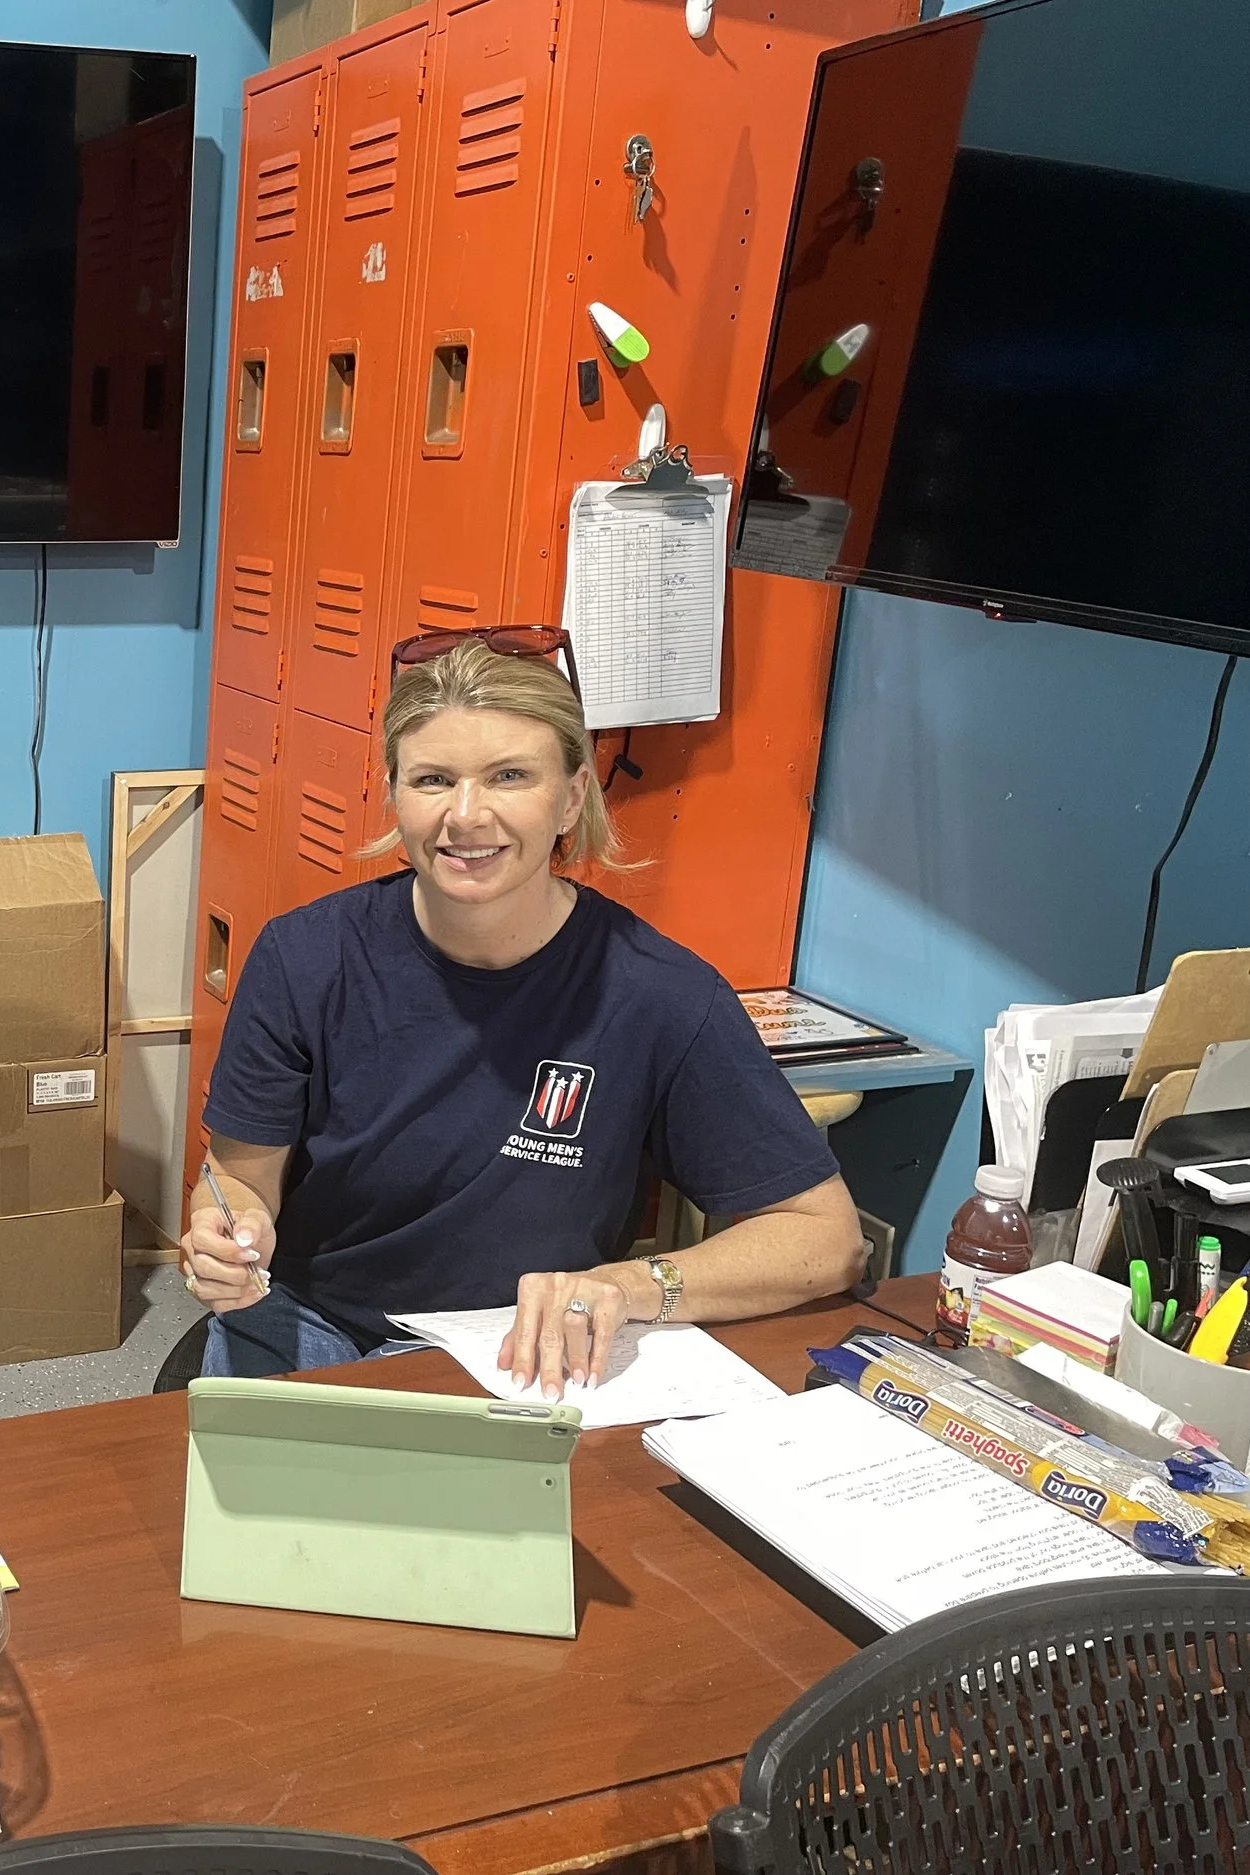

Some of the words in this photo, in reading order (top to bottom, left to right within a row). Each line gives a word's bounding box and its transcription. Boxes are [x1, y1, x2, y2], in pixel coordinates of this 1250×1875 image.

[500, 1145, 540, 1161] SERVICE
[507, 1134, 546, 1152] OUNG
[547, 1143, 584, 1157] MEN'S
[878, 1387, 925, 1416] Doria
[943, 1420, 1028, 1476] Spaghetti
[1047, 1479, 1104, 1510] Doria
